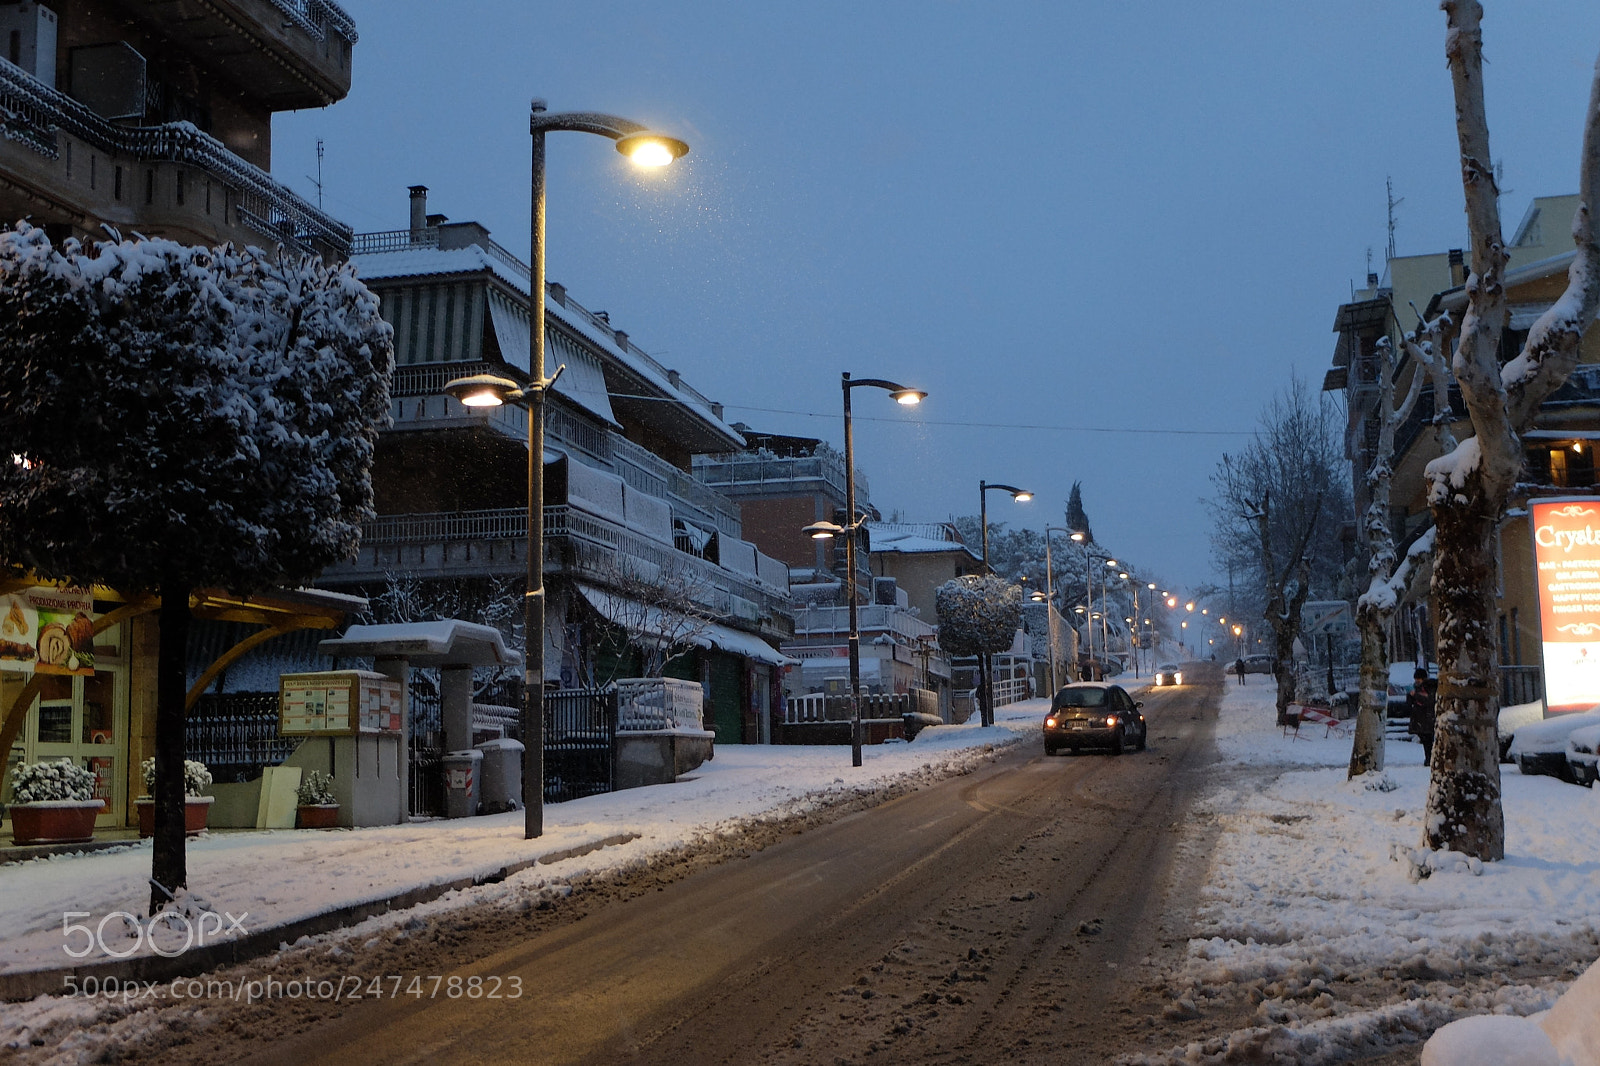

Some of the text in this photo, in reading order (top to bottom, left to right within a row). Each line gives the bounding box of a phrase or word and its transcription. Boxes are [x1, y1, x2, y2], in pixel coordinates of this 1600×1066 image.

[28, 595, 92, 611] PRODUZIONE PROPRIA
[1553, 604, 1582, 613] FINGER
